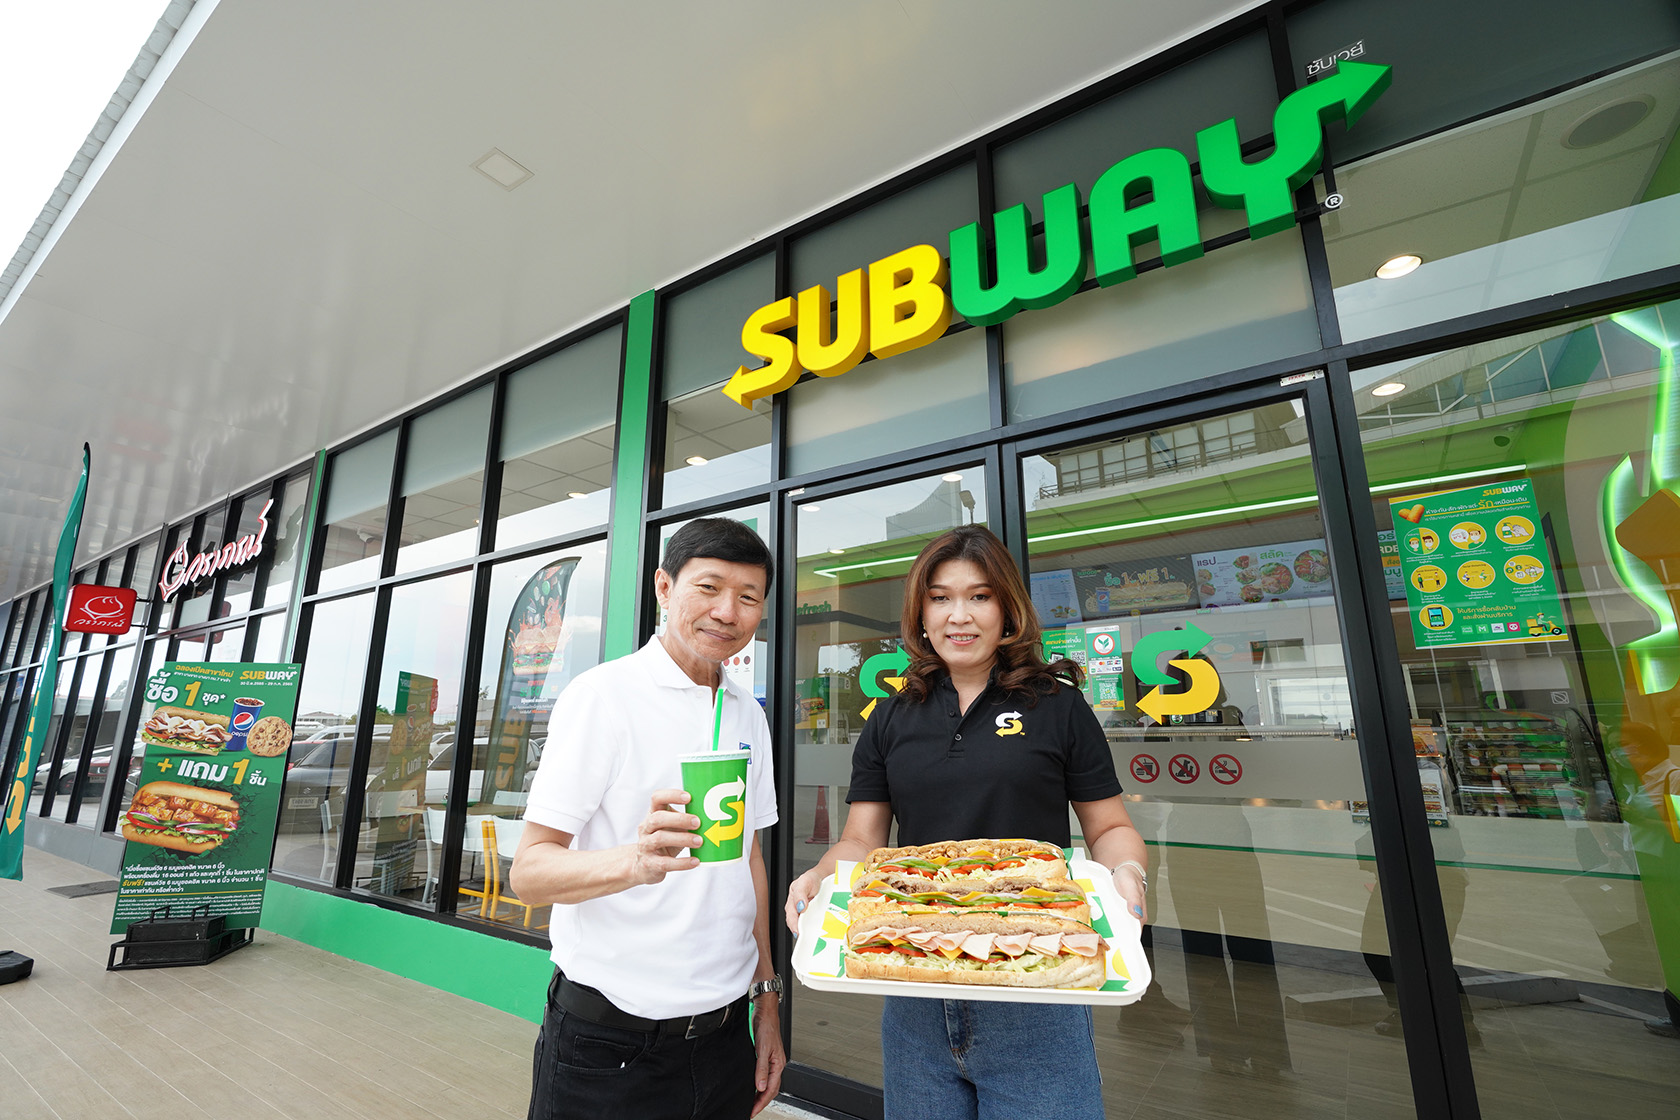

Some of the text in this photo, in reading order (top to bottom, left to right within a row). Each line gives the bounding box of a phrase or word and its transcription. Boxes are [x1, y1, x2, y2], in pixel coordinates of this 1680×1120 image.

[722, 59, 1392, 409] SUBWAY
[1482, 484, 1528, 497] SUBWAY
[1197, 556, 1217, 567] แรป
[1259, 550, 1284, 560] สลัด
[1138, 568, 1160, 583] ฟรี
[175, 664, 235, 678] ฉลองเปิดสาขาใหม่
[239, 670, 298, 680] SUBWAY
[146, 671, 178, 703] ซื้อ
[185, 681, 202, 706] 1
[177, 759, 229, 783] แถม
[232, 759, 250, 785] 1
[249, 770, 267, 786] ชิ้น
